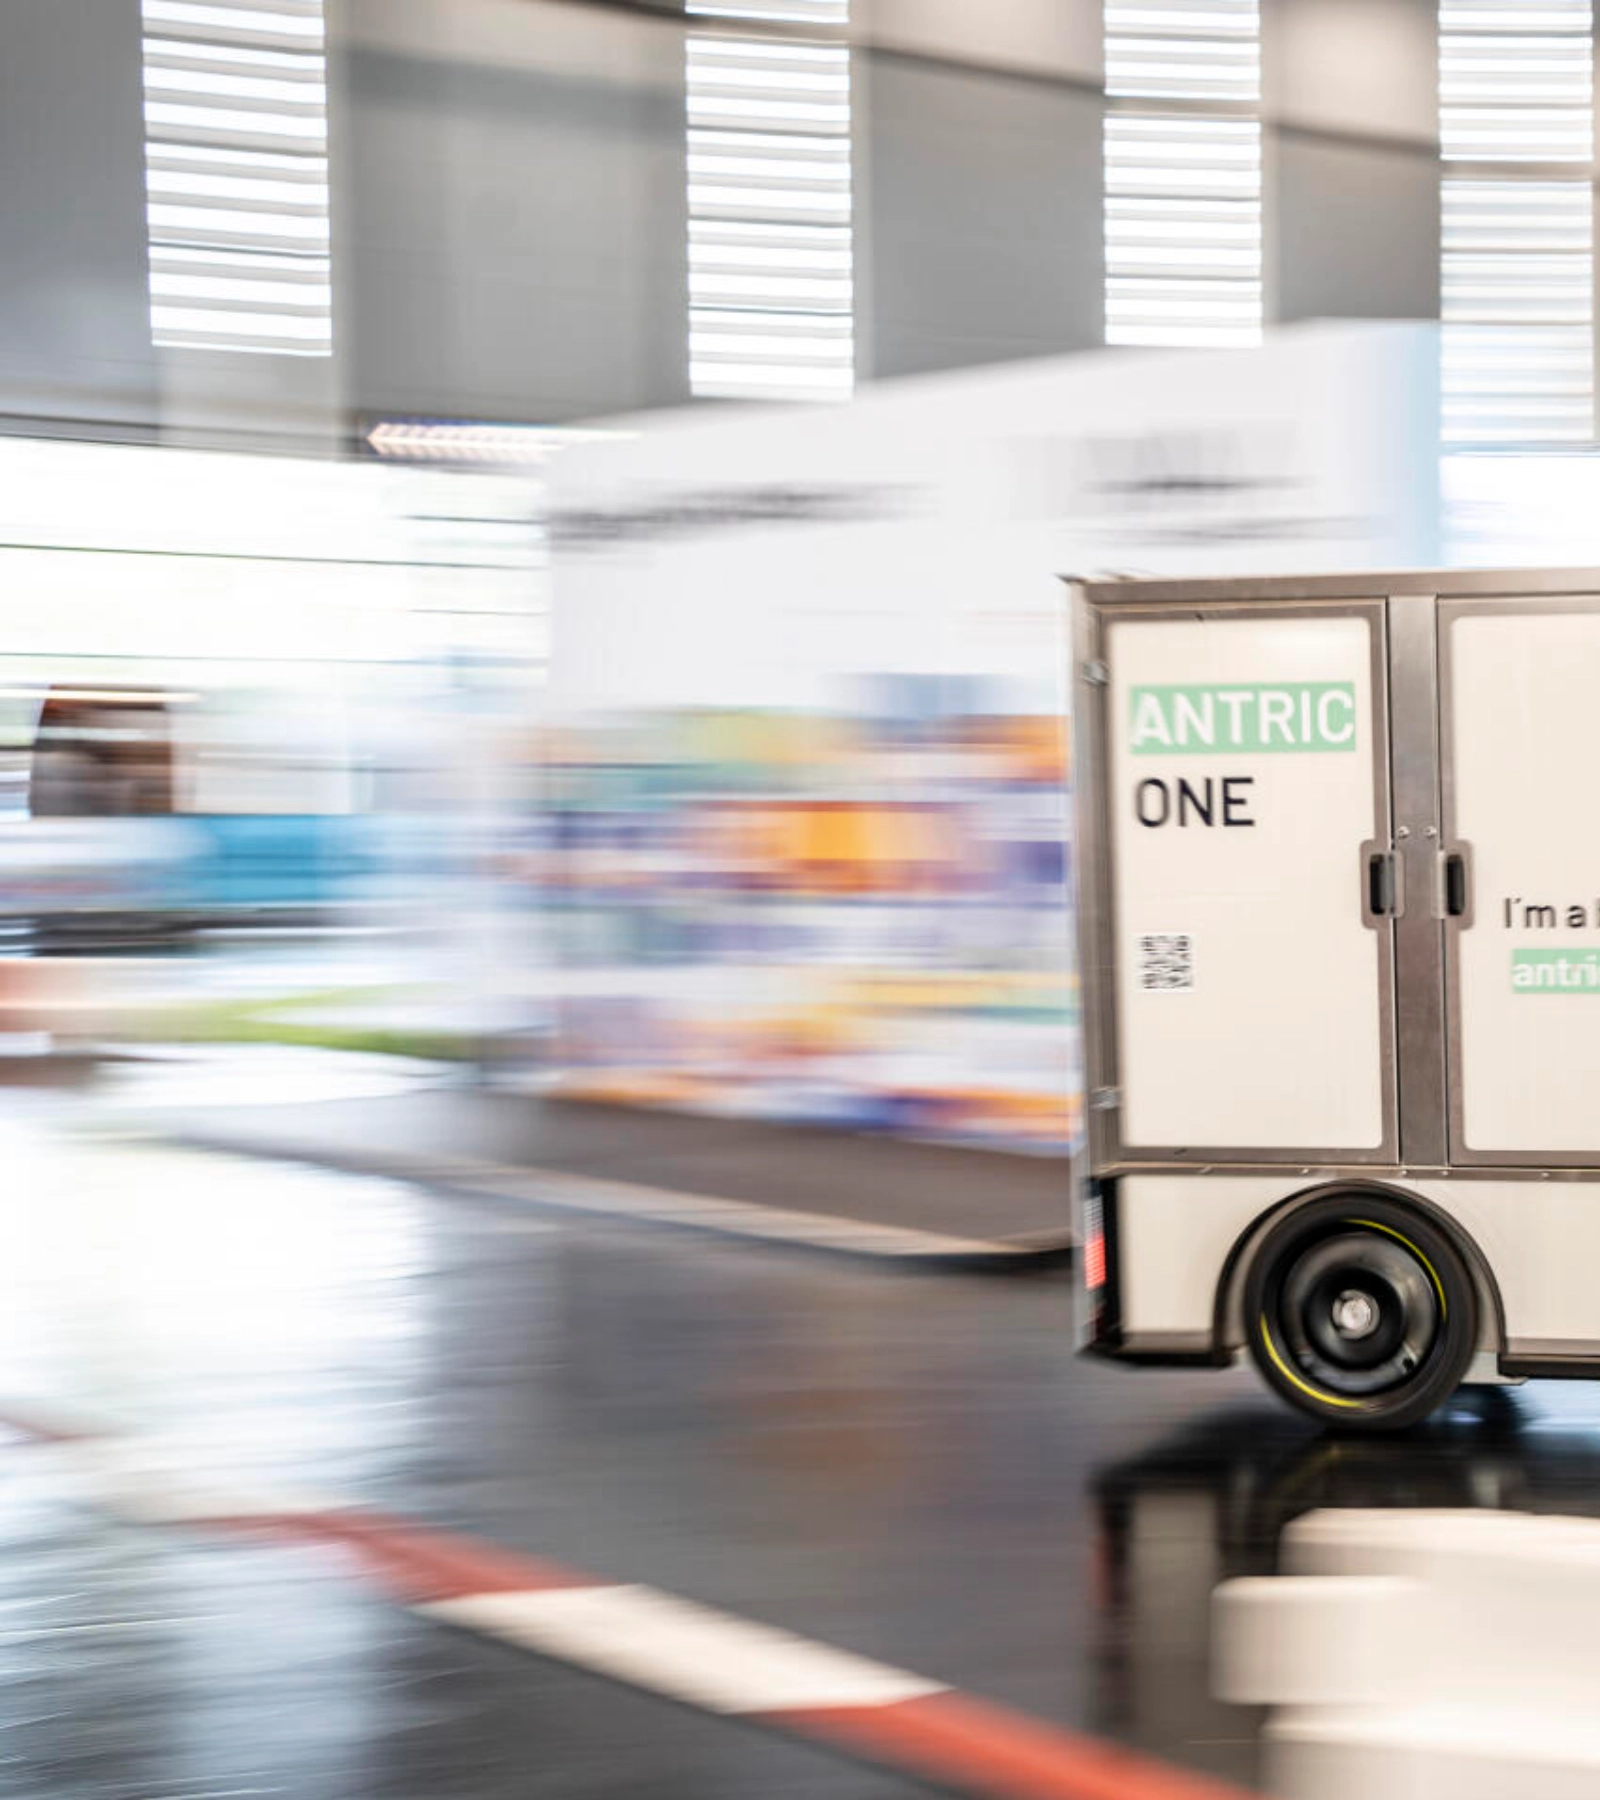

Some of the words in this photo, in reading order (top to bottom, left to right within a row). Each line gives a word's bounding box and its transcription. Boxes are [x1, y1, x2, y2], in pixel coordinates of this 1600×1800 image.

[1131, 690, 1354, 745] ANTRIC
[1135, 776, 1255, 827] ONE
[1567, 905, 1586, 928] a
